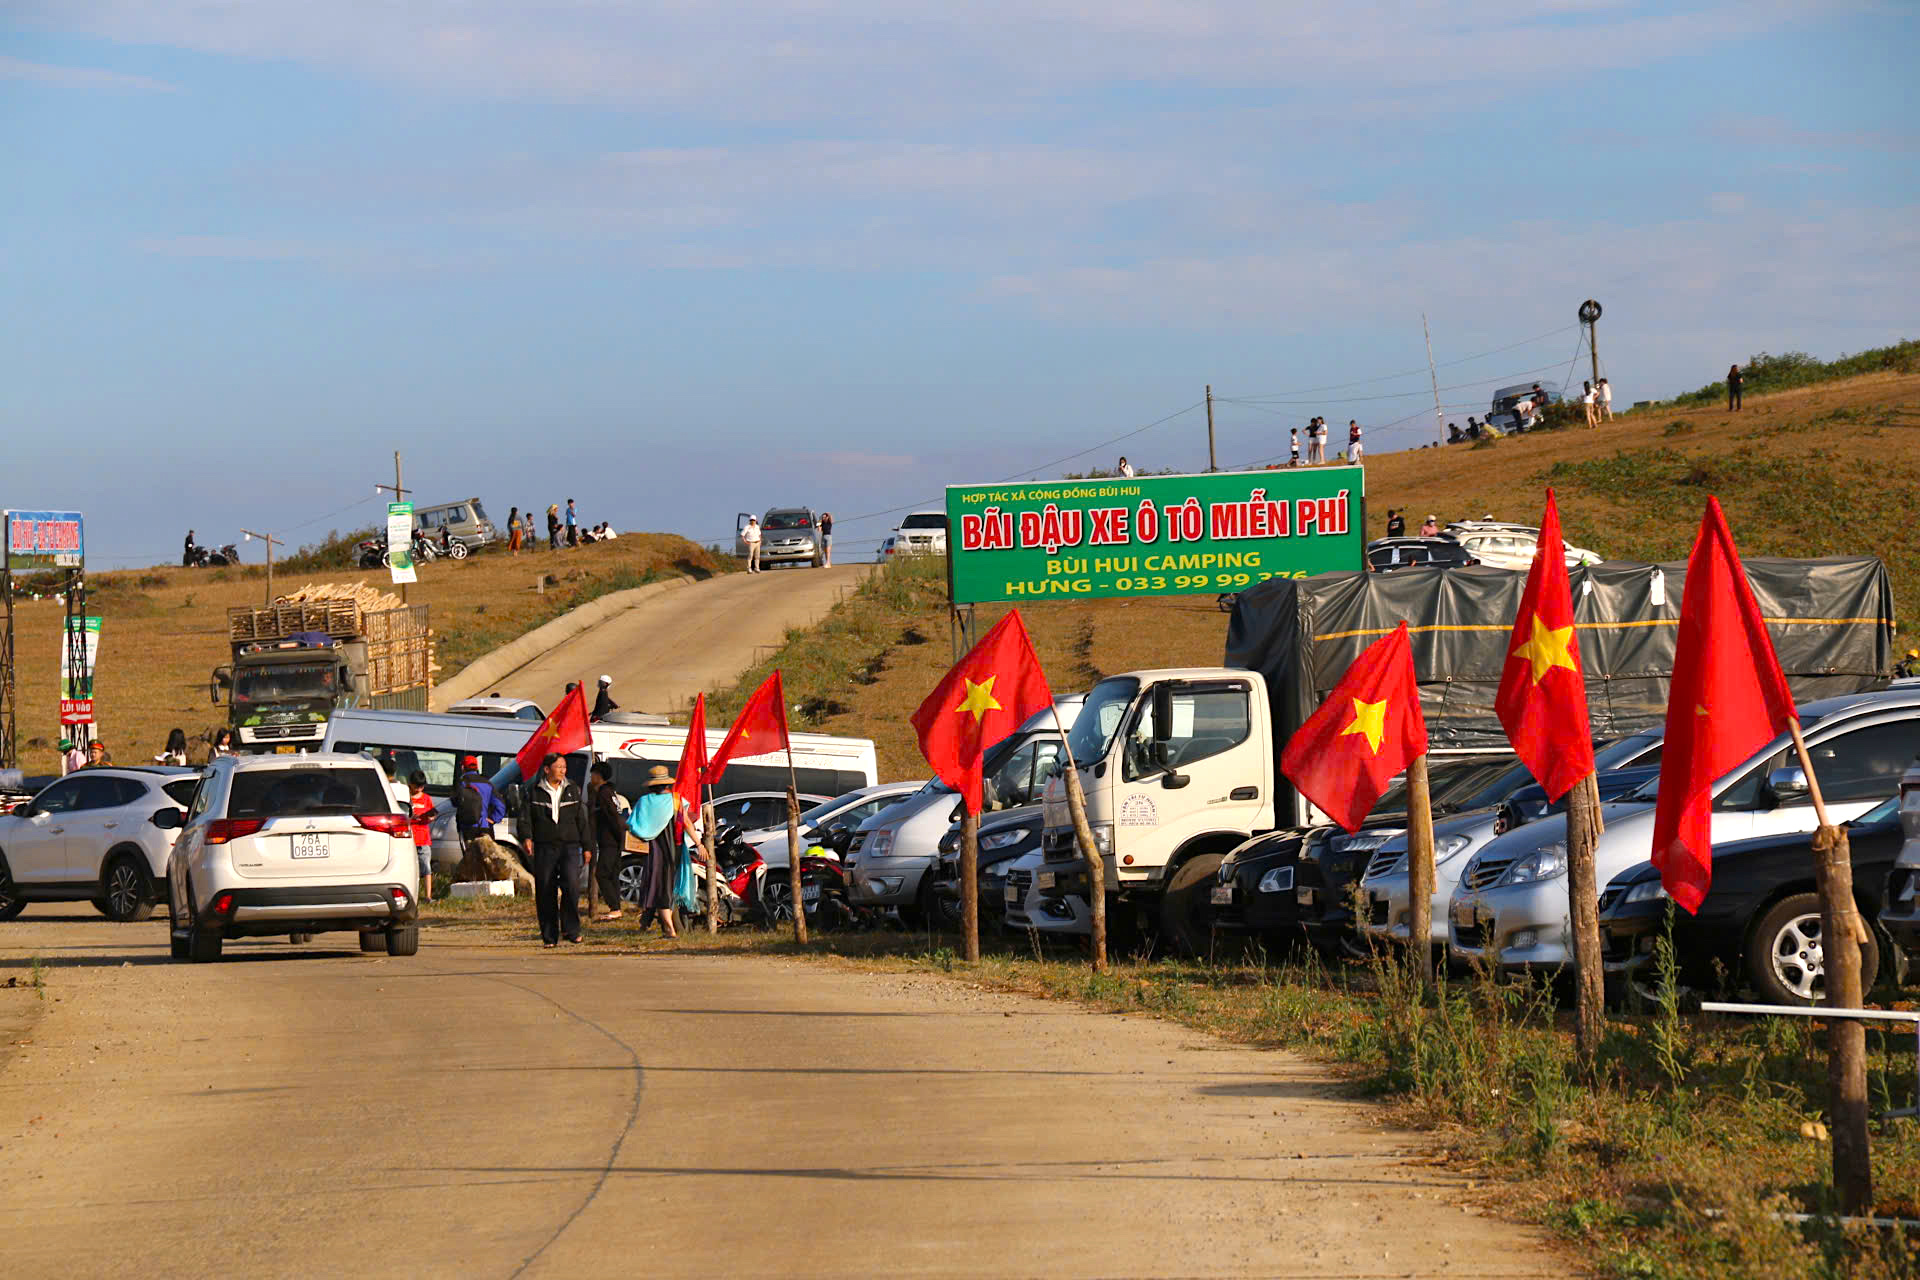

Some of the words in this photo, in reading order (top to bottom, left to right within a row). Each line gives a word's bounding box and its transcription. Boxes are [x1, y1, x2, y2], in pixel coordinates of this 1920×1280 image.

[962, 493, 986, 504] HỢP
[989, 490, 1009, 502] TÁC
[1029, 488, 1061, 500] CỘNG
[1063, 485, 1097, 499] ĐỒNG
[1099, 486, 1118, 497] BÙI
[1120, 486, 1141, 496] HUI
[961, 506, 1014, 550] BÃI
[1019, 503, 1082, 554] ĐẬU
[1088, 507, 1129, 545] XE
[1136, 499, 1158, 544] Ô
[1164, 497, 1203, 541] TÔ
[1210, 488, 1289, 540] MIỄN
[1296, 489, 1349, 536] PHÍ
[1047, 556, 1088, 575] BÙI
[1095, 557, 1138, 573] HUI
[1144, 551, 1261, 571] CAMPING
[1005, 578, 1092, 595] HƯNG
[1115, 576, 1167, 591] 033
[1174, 575, 1209, 589] 99
[1215, 573, 1250, 587] 99
[301, 834, 320, 845] 76A
